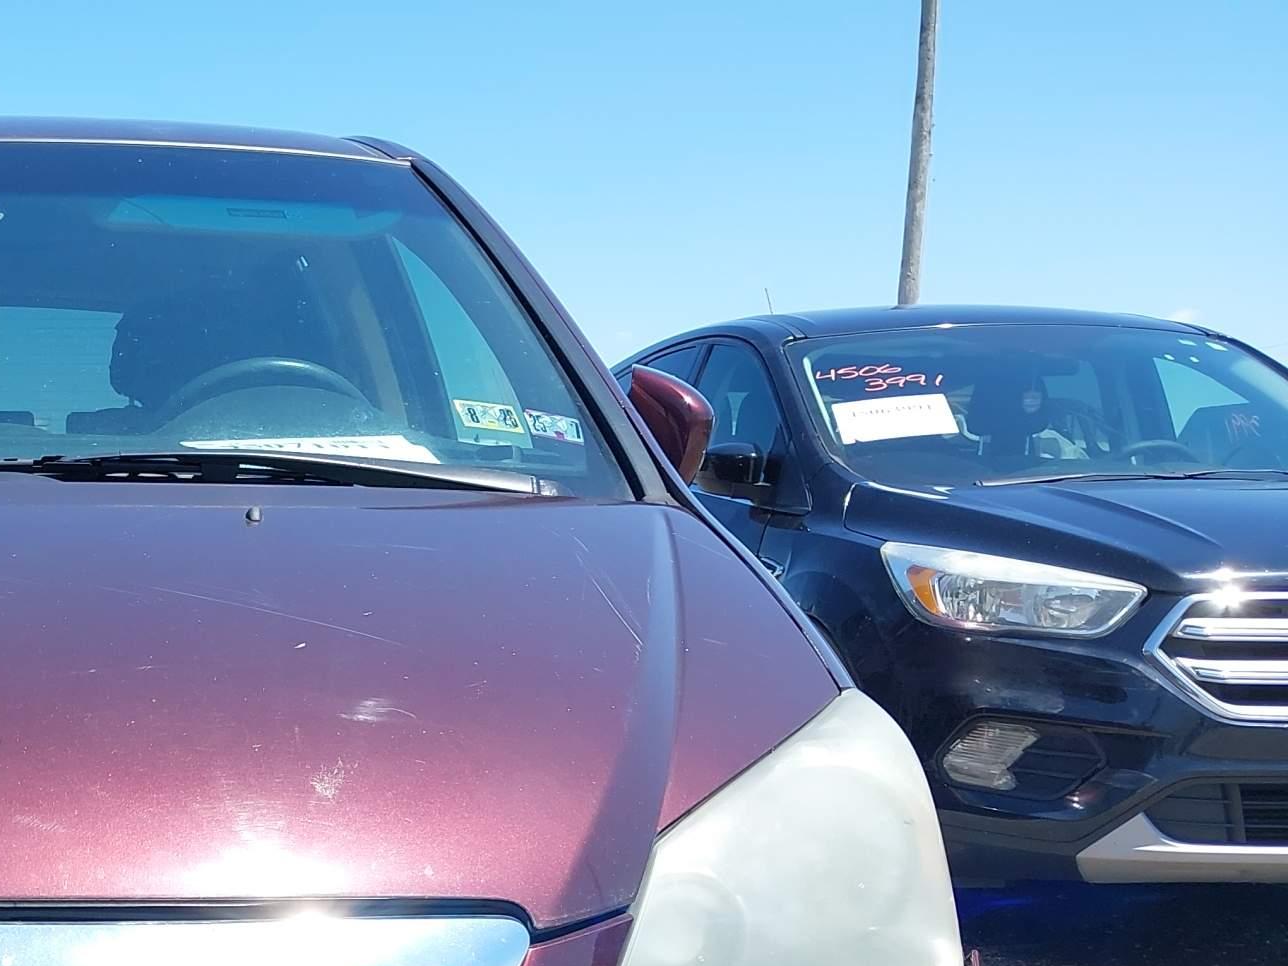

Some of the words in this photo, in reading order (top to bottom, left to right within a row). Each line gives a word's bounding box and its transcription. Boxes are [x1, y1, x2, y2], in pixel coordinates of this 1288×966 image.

[816, 364, 901, 380] 4506
[865, 375, 943, 391] 3991
[467, 407, 480, 424] 8
